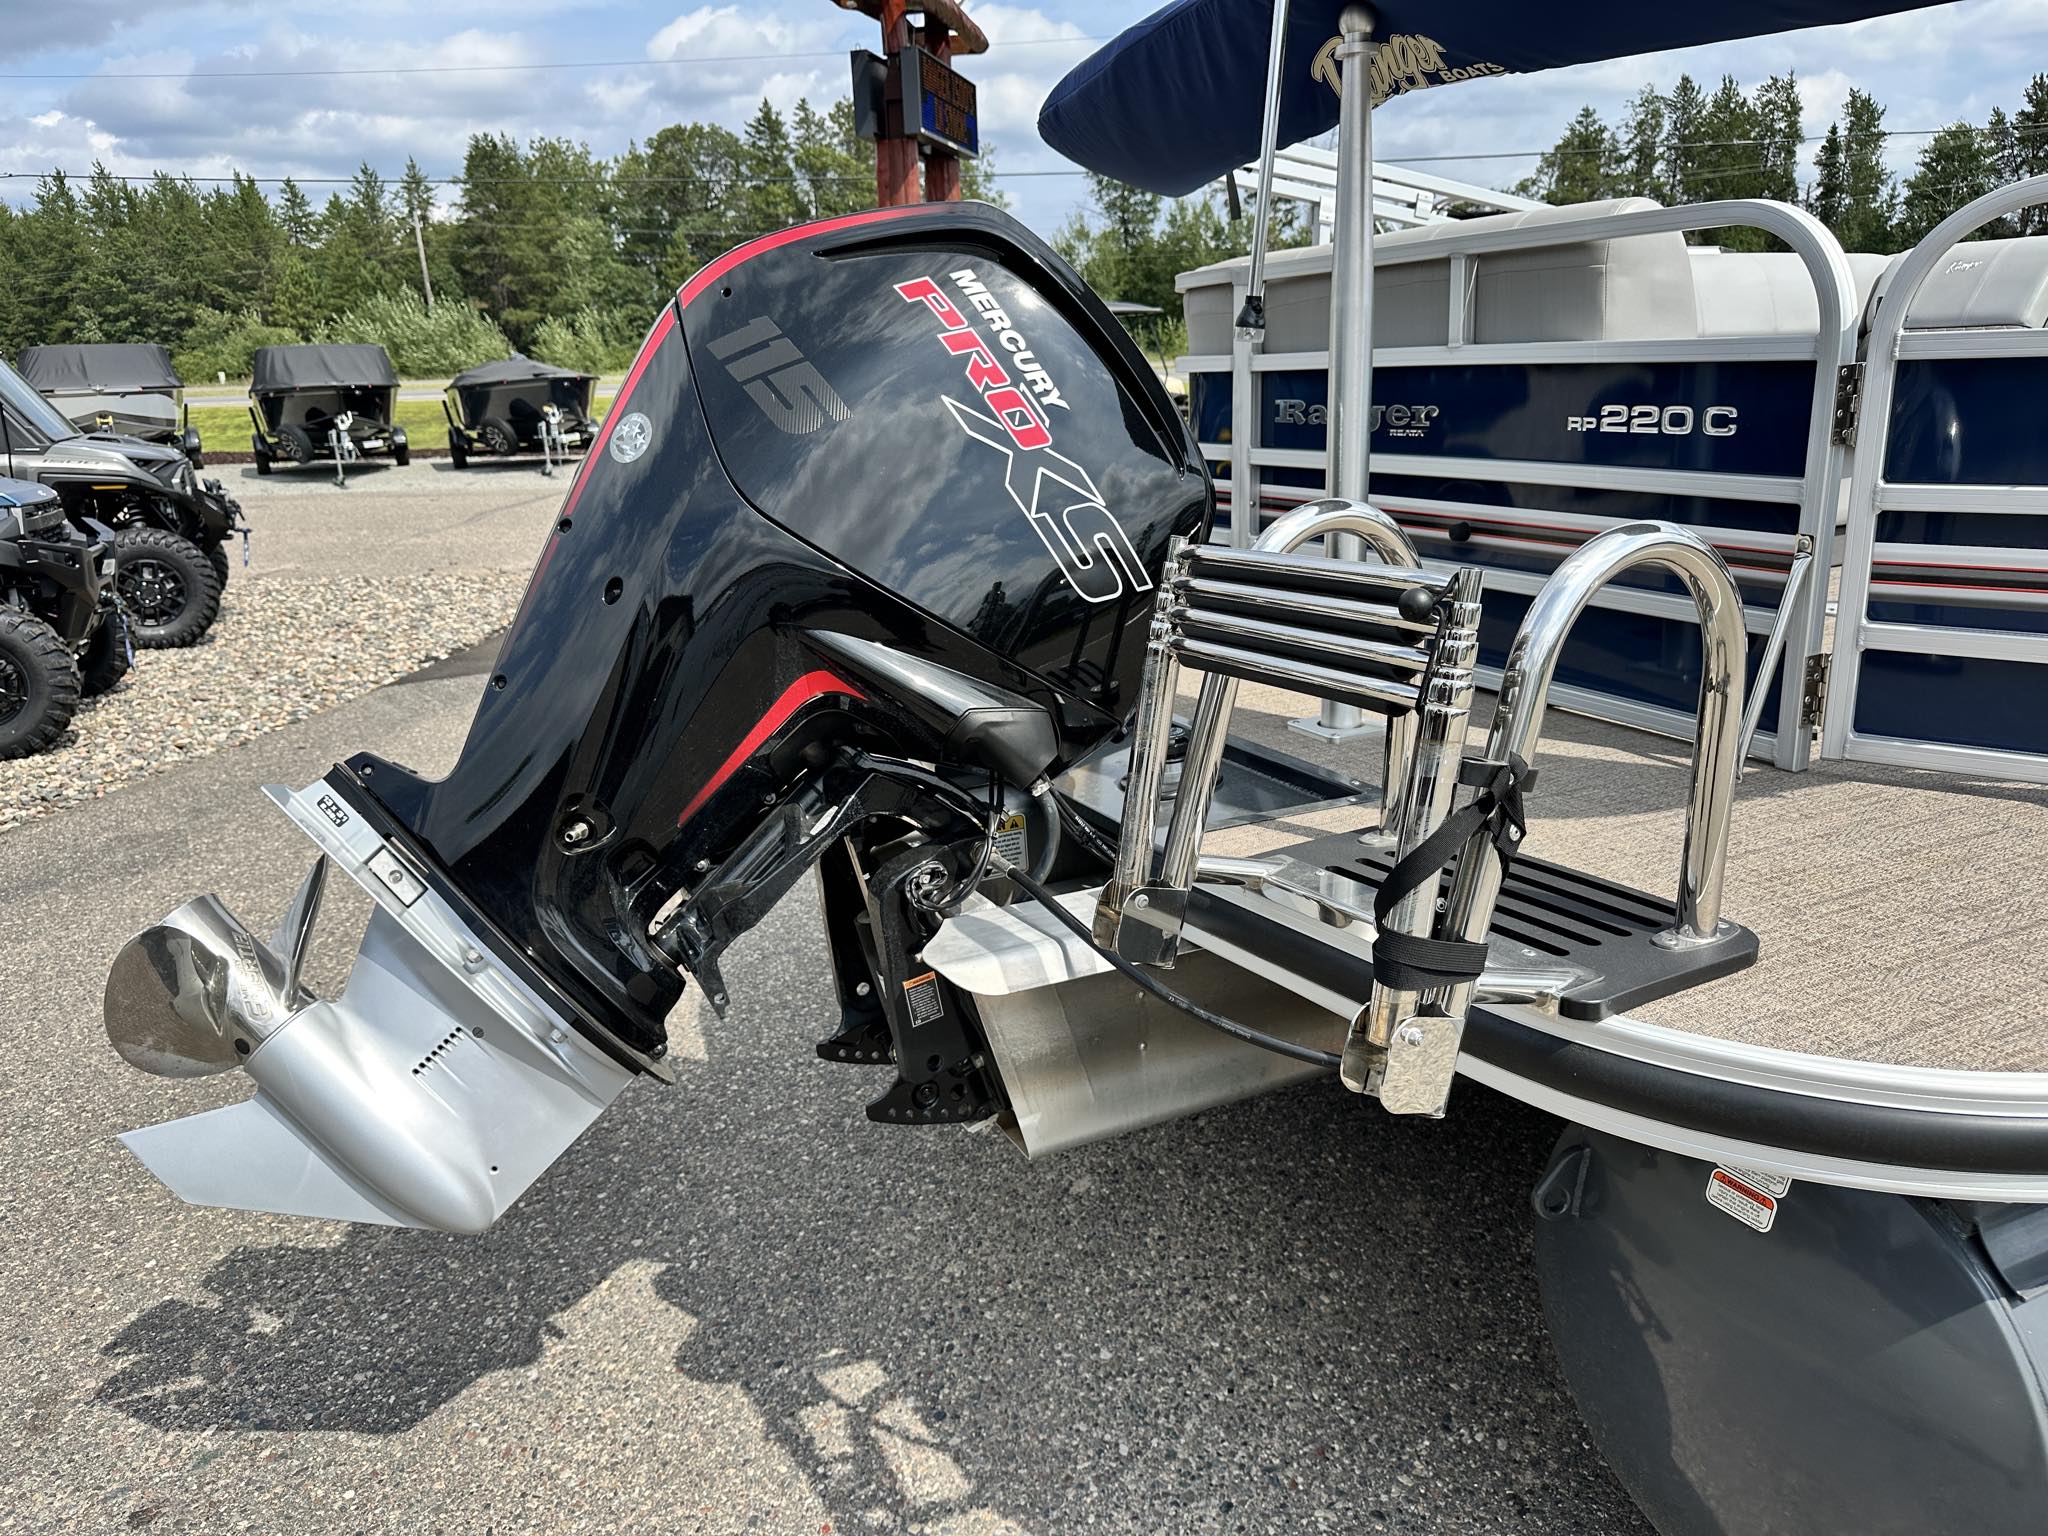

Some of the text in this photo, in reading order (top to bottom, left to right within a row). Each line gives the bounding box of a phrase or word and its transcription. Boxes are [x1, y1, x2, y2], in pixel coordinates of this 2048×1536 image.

[1439, 62, 1505, 83] BOATS
[706, 315, 854, 435] 115
[894, 276, 1053, 450] PRO
[948, 268, 1070, 411] MERCURY
[1274, 399, 1439, 432] Raer
[941, 386, 1153, 602] XS
[1727, 1178, 1759, 1201] WARNING
